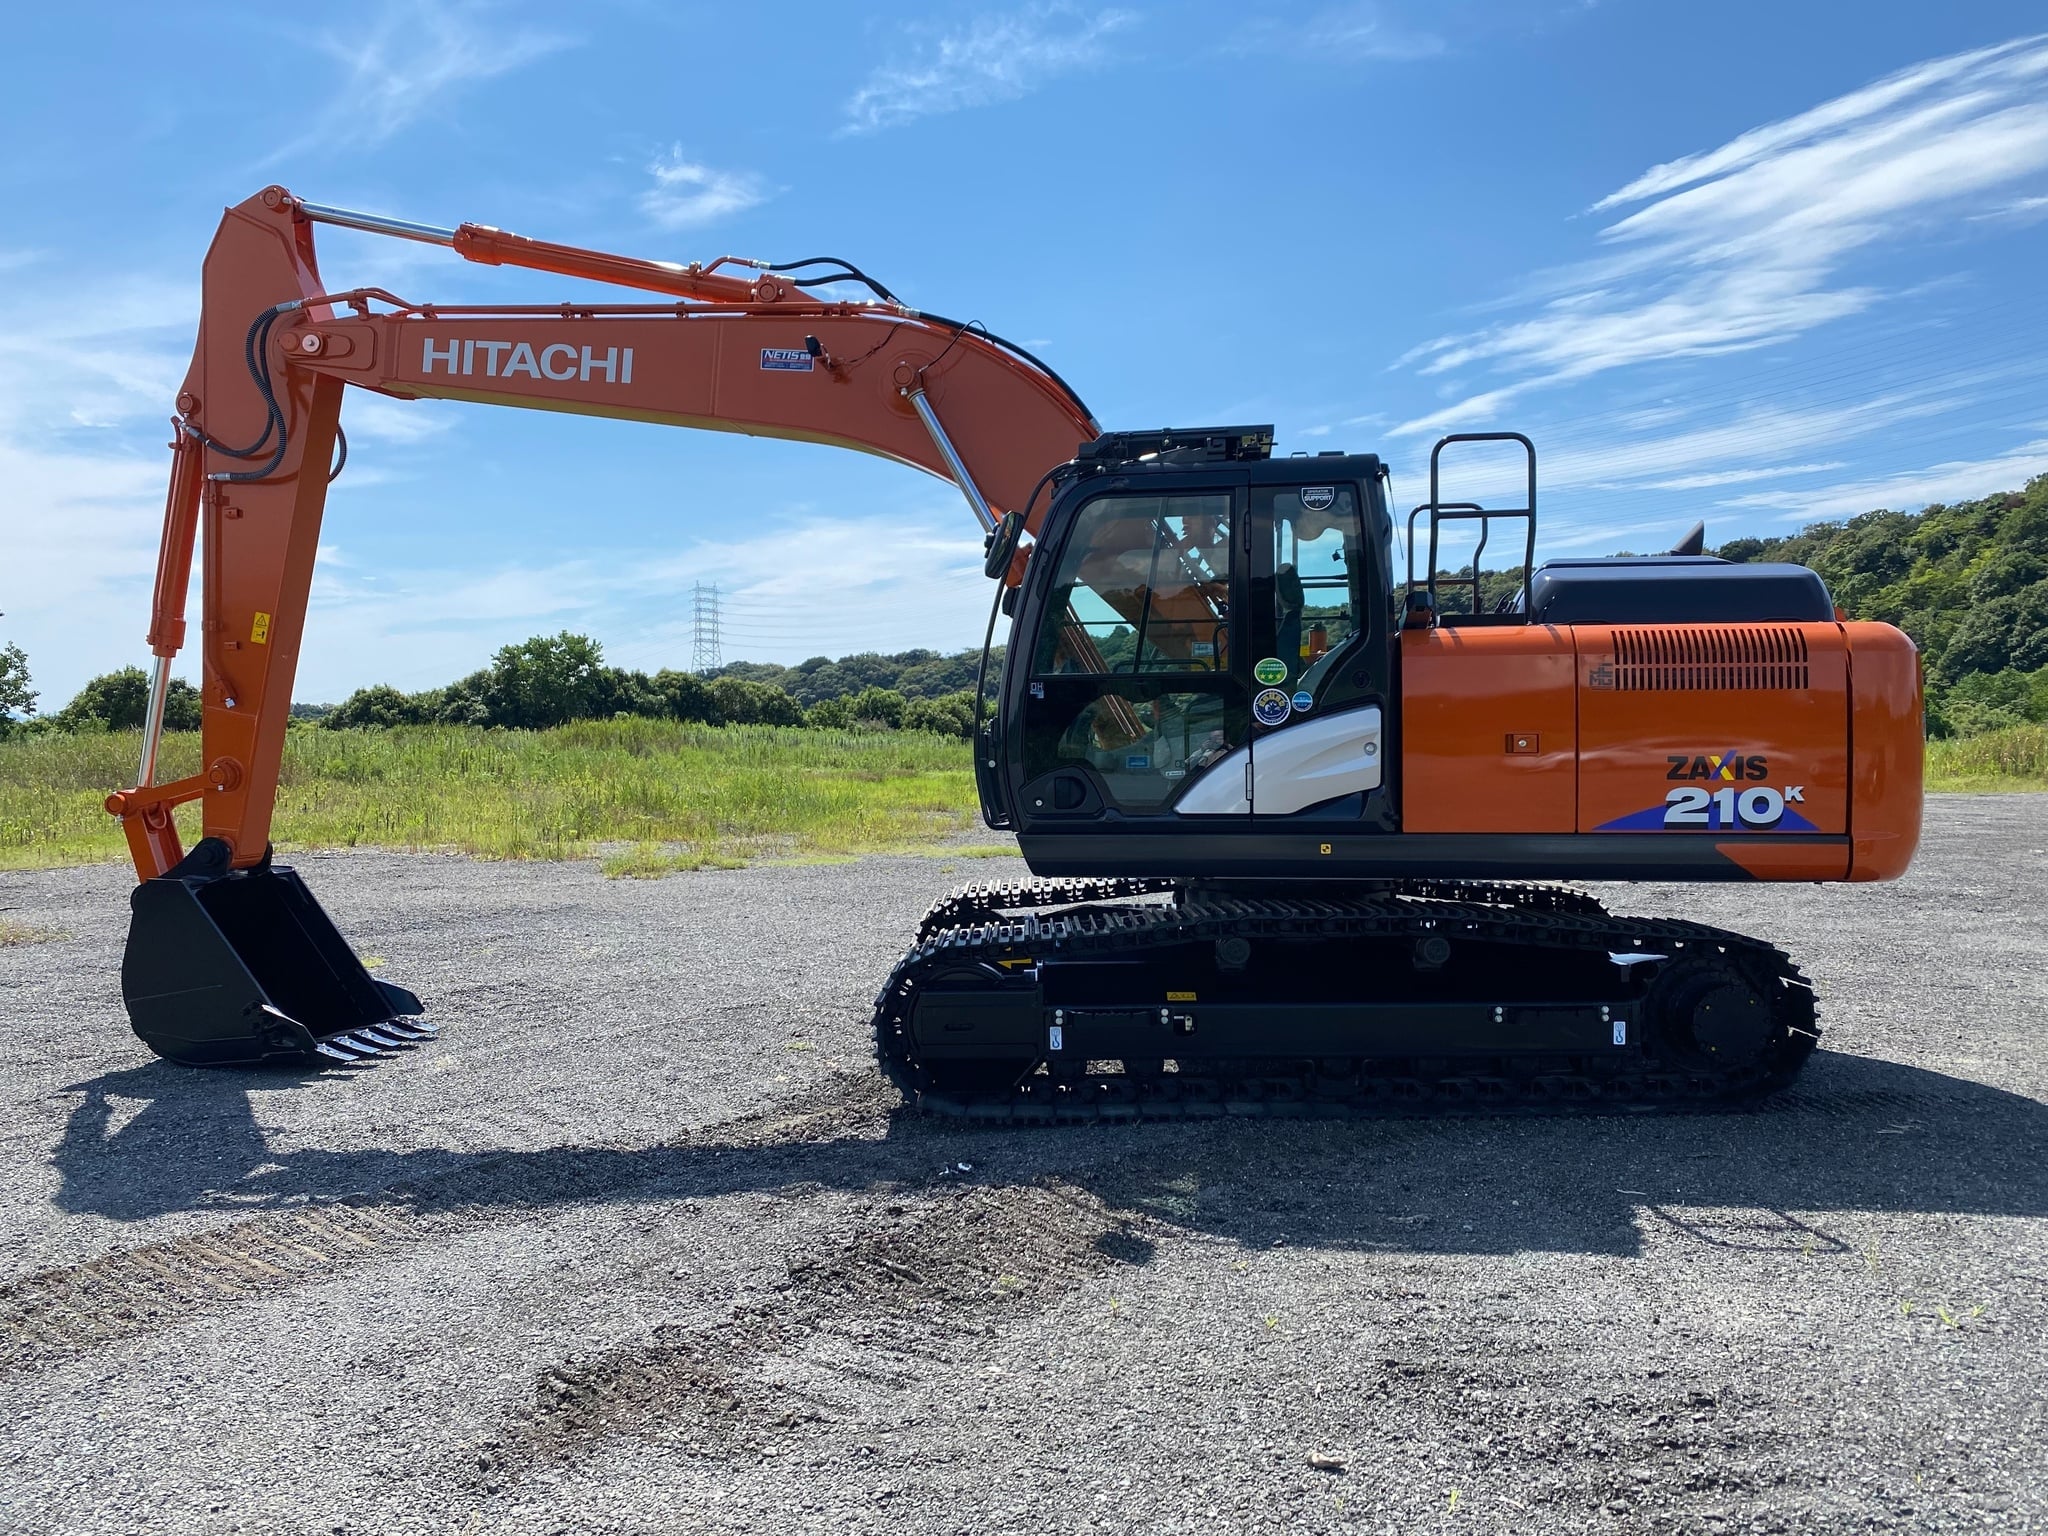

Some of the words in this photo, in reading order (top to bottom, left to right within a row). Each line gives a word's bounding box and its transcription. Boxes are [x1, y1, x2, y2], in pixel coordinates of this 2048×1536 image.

[422, 338, 634, 384] HITACHI
[764, 350, 799, 360] NETIS
[1666, 750, 1768, 781] ZAXIS
